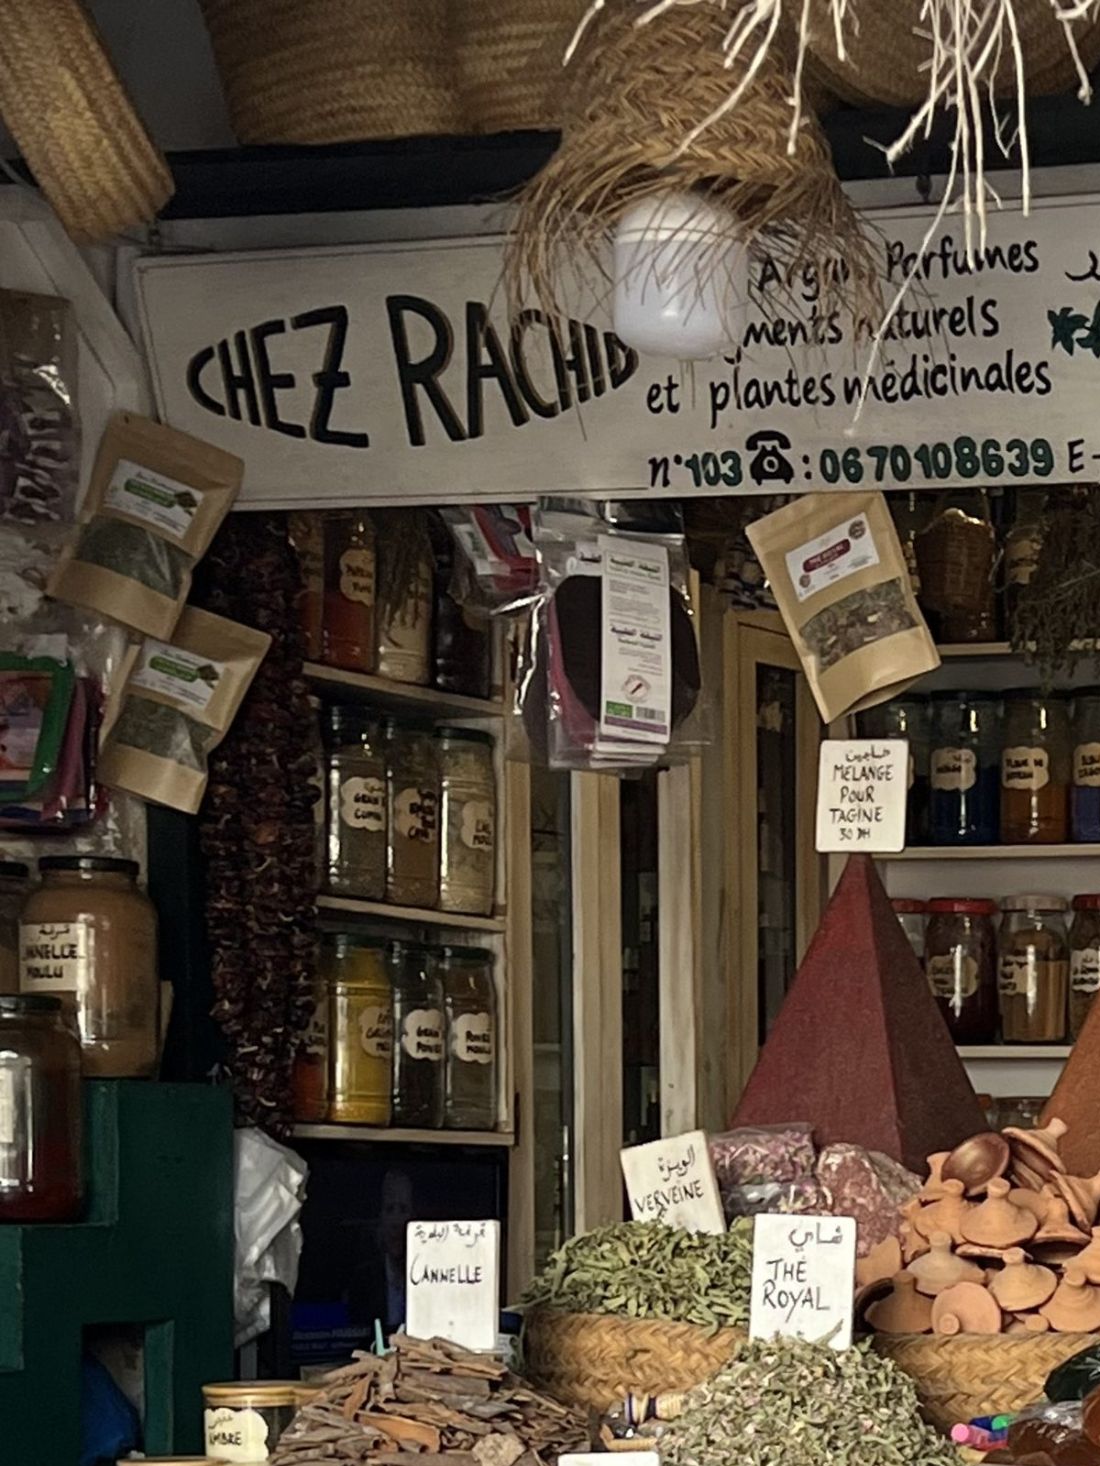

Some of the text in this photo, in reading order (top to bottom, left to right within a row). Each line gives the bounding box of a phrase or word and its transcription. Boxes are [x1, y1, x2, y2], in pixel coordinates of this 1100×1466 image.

[186, 294, 640, 448] CHEZ RACHID
[646, 349, 1053, 428] et plantes médicinales
[833, 764, 894, 782] MELANGE
[829, 805, 884, 824] TAGINE
[634, 1180, 705, 1214] VERVEINE
[788, 1222, 844, 1253] شاي
[409, 1252, 483, 1286] CANNELLE
[762, 1278, 832, 1324] ROYAL
